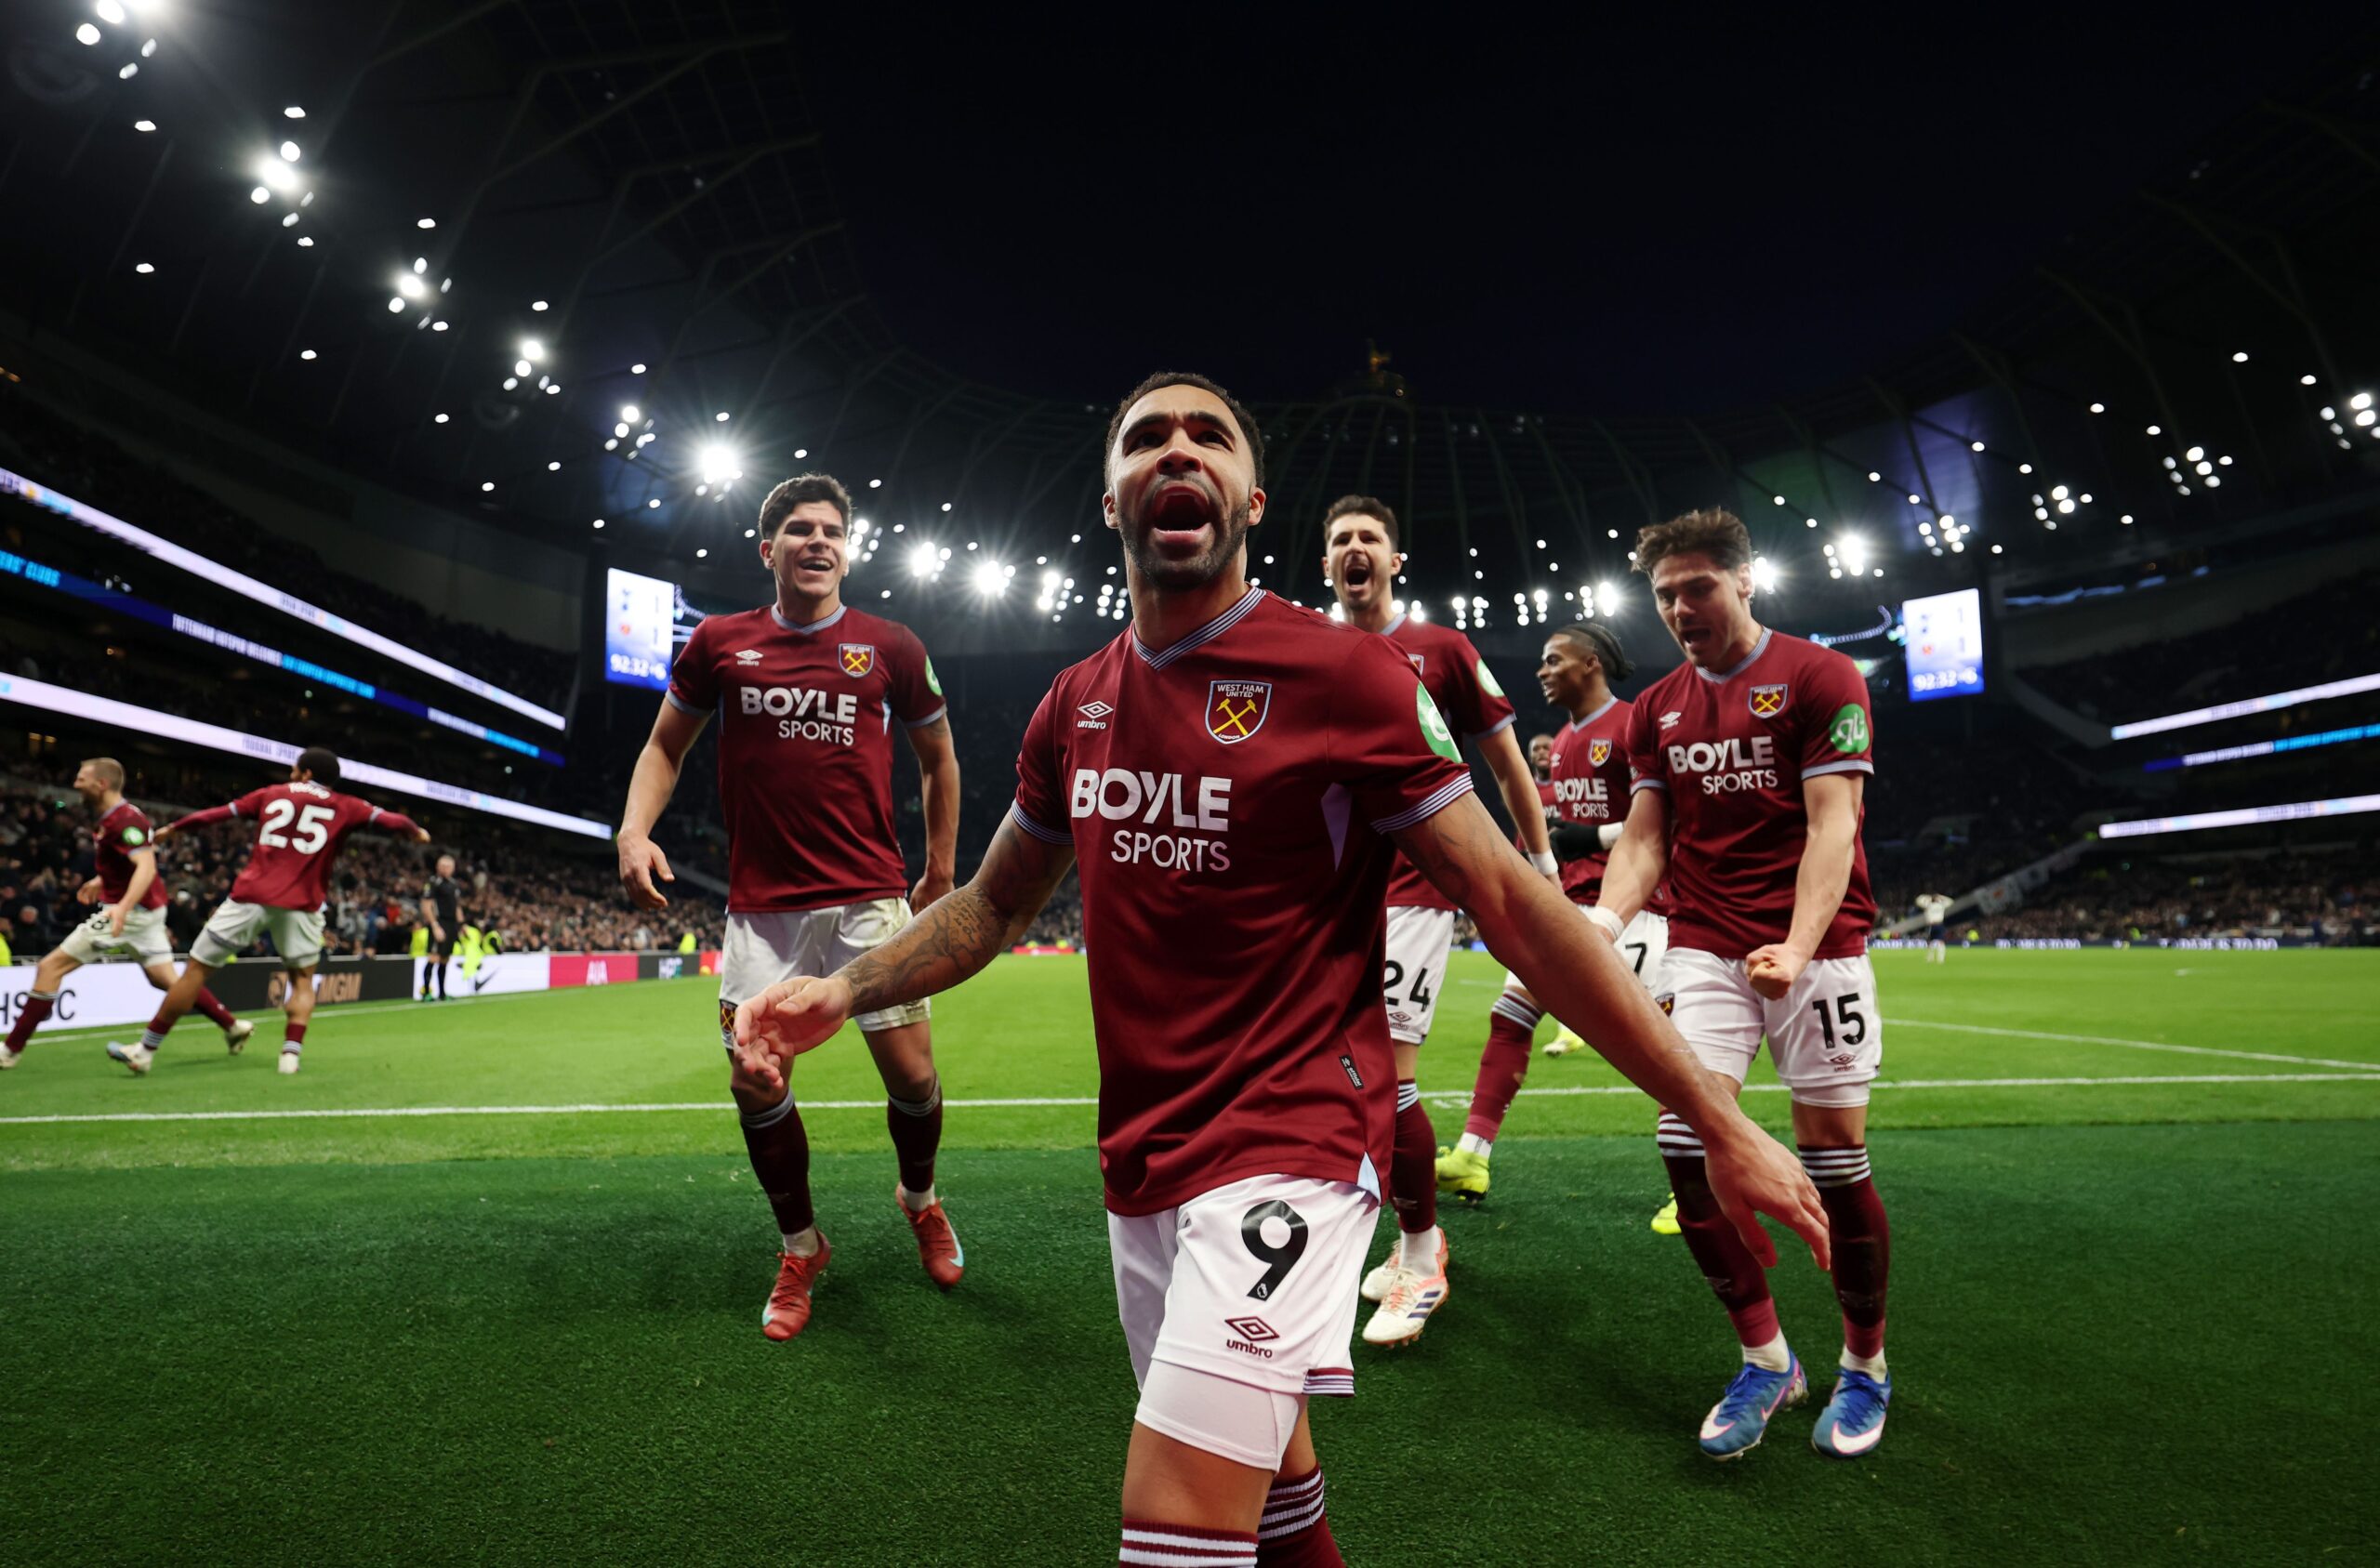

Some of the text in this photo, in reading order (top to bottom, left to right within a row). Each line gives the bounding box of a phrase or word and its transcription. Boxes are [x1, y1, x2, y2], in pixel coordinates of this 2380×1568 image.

[741, 686, 858, 724] BOYLE
[1217, 684, 1264, 694] WEST HAM
[778, 719, 854, 746] SPORTS
[1077, 718, 1106, 730] umbro
[1668, 736, 1775, 774] BOYLE
[1071, 768, 1233, 832] BOYLE
[1554, 778, 1608, 803] BOYLE
[1701, 770, 1778, 796] SPORTS
[258, 798, 336, 855] 25
[1110, 830, 1232, 872] SPORTS
[1384, 960, 1431, 1012] 24
[1812, 993, 1866, 1048] 15
[1241, 1200, 1309, 1301] 9
[1226, 1338, 1273, 1359] umbro
